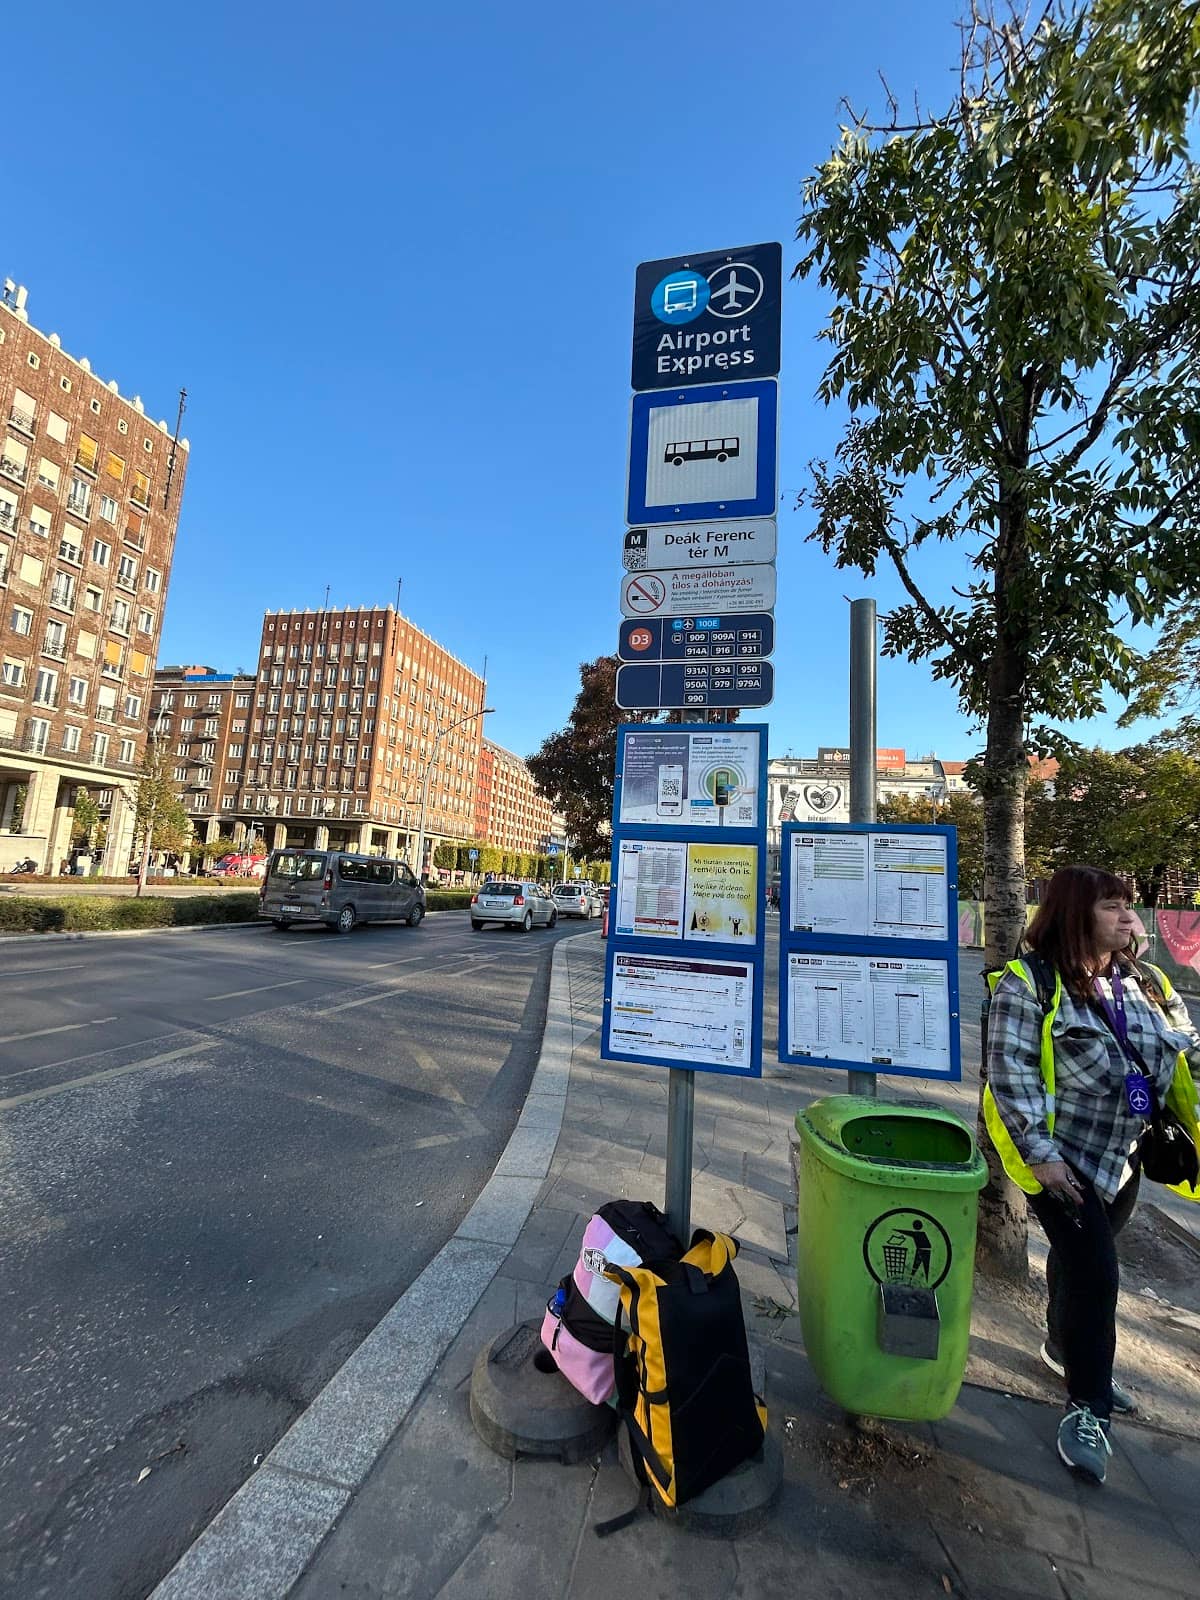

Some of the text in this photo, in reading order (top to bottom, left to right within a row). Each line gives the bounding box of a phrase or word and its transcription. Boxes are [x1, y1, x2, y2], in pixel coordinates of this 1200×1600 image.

[656, 324, 751, 352] Airport
[657, 349, 755, 375] Express
[630, 535, 640, 544] M
[664, 530, 756, 546] Deák Ferenc
[688, 546, 728, 558] tér M
[682, 570, 734, 580] megállóban
[672, 582, 691, 590] tilos
[702, 578, 754, 588] dohányzás!
[631, 634, 649, 645] D3
[694, 866, 727, 875] reméljük
